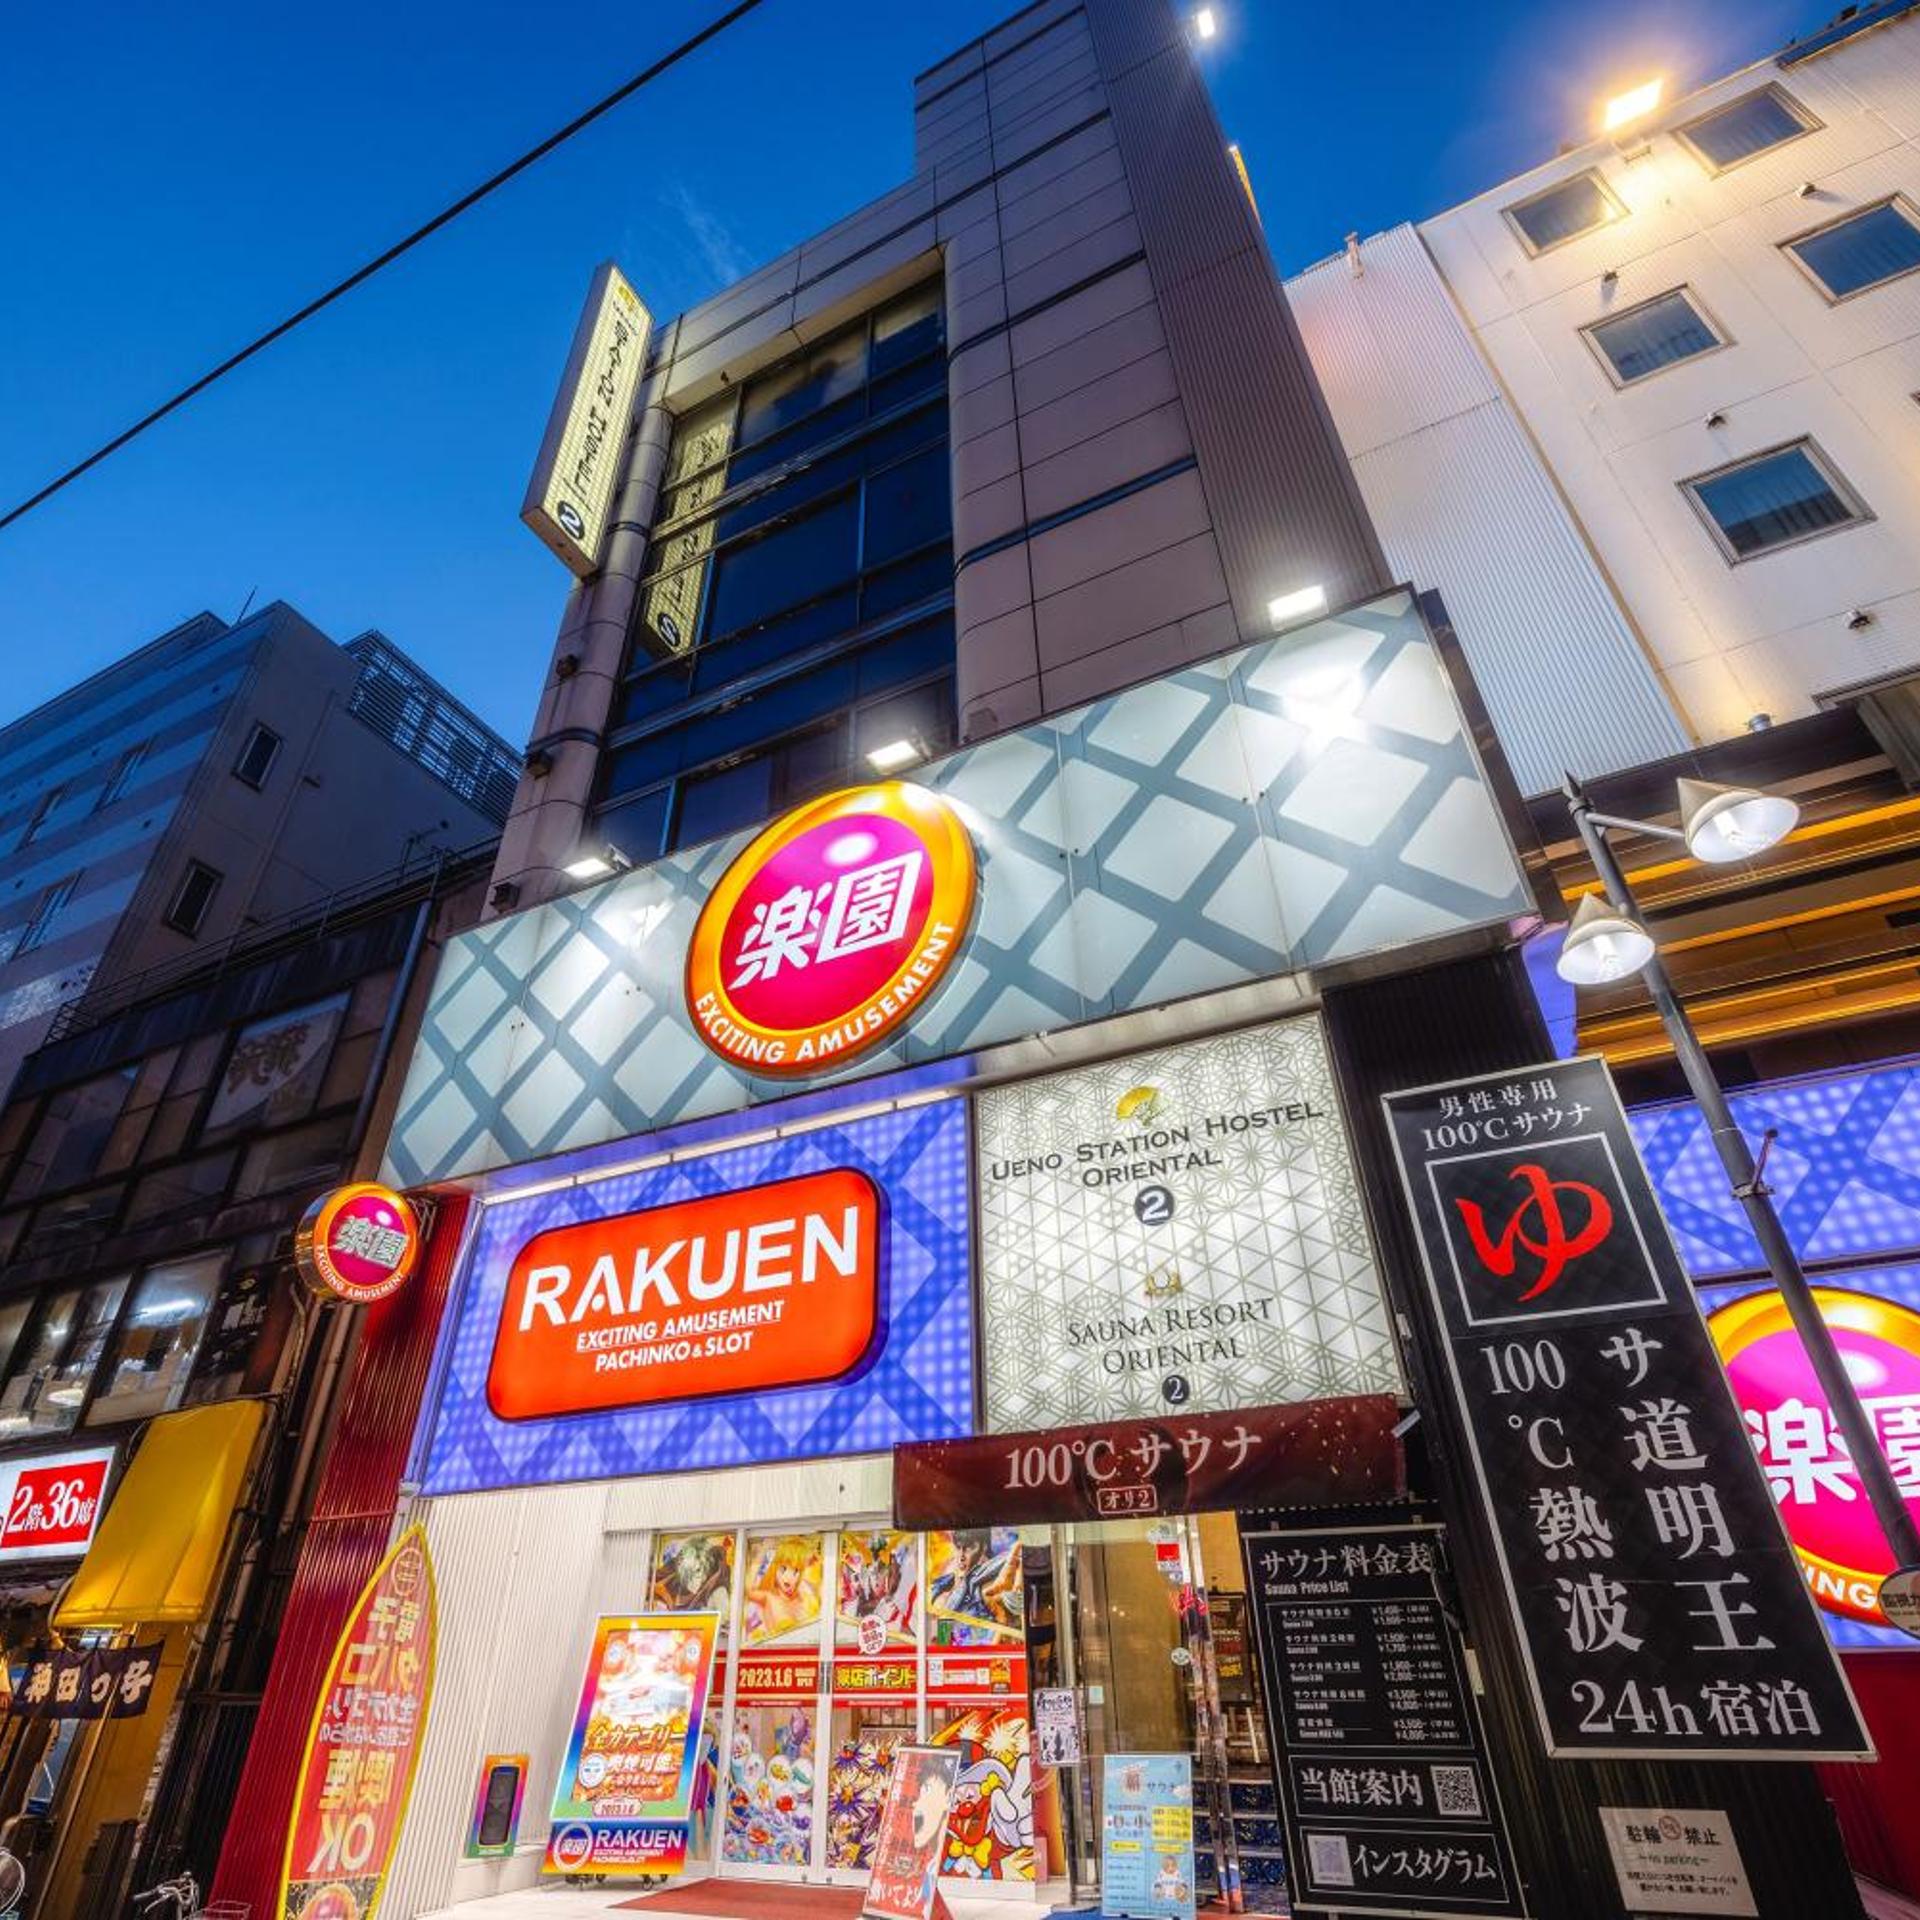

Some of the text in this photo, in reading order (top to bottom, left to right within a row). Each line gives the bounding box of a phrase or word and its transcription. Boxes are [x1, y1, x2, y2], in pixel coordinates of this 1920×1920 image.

[728, 849, 923, 991] 楽園
[695, 921, 955, 1063] EXCITING AMUSEMENT
[1439, 1078, 1558, 1119] 男性専用
[1082, 1150, 1223, 1188] ORIENTAL
[329, 1215, 411, 1270] 楽園
[1456, 1163, 1614, 1302] ゆ
[518, 1206, 859, 1331] RAKUEN
[576, 1300, 785, 1350] EXCITING AMUSEMENT
[1068, 1298, 1274, 1346] SAUNA RESORT
[1103, 1337, 1246, 1374] ORIENTAL
[1600, 1327, 1777, 1651] サ道明王
[1260, 1541, 1433, 1579] サウナ料金表
[1300, 1582, 1329, 1594] Price
[739, 1667, 793, 1688] 2023.1.6
[1571, 1678, 1823, 1737] 24h宿泊
[1300, 1766, 1425, 1808] 当館案内
[595, 1829, 684, 1849] RAKUEN
[1354, 1844, 1498, 1882] インスタグラム
